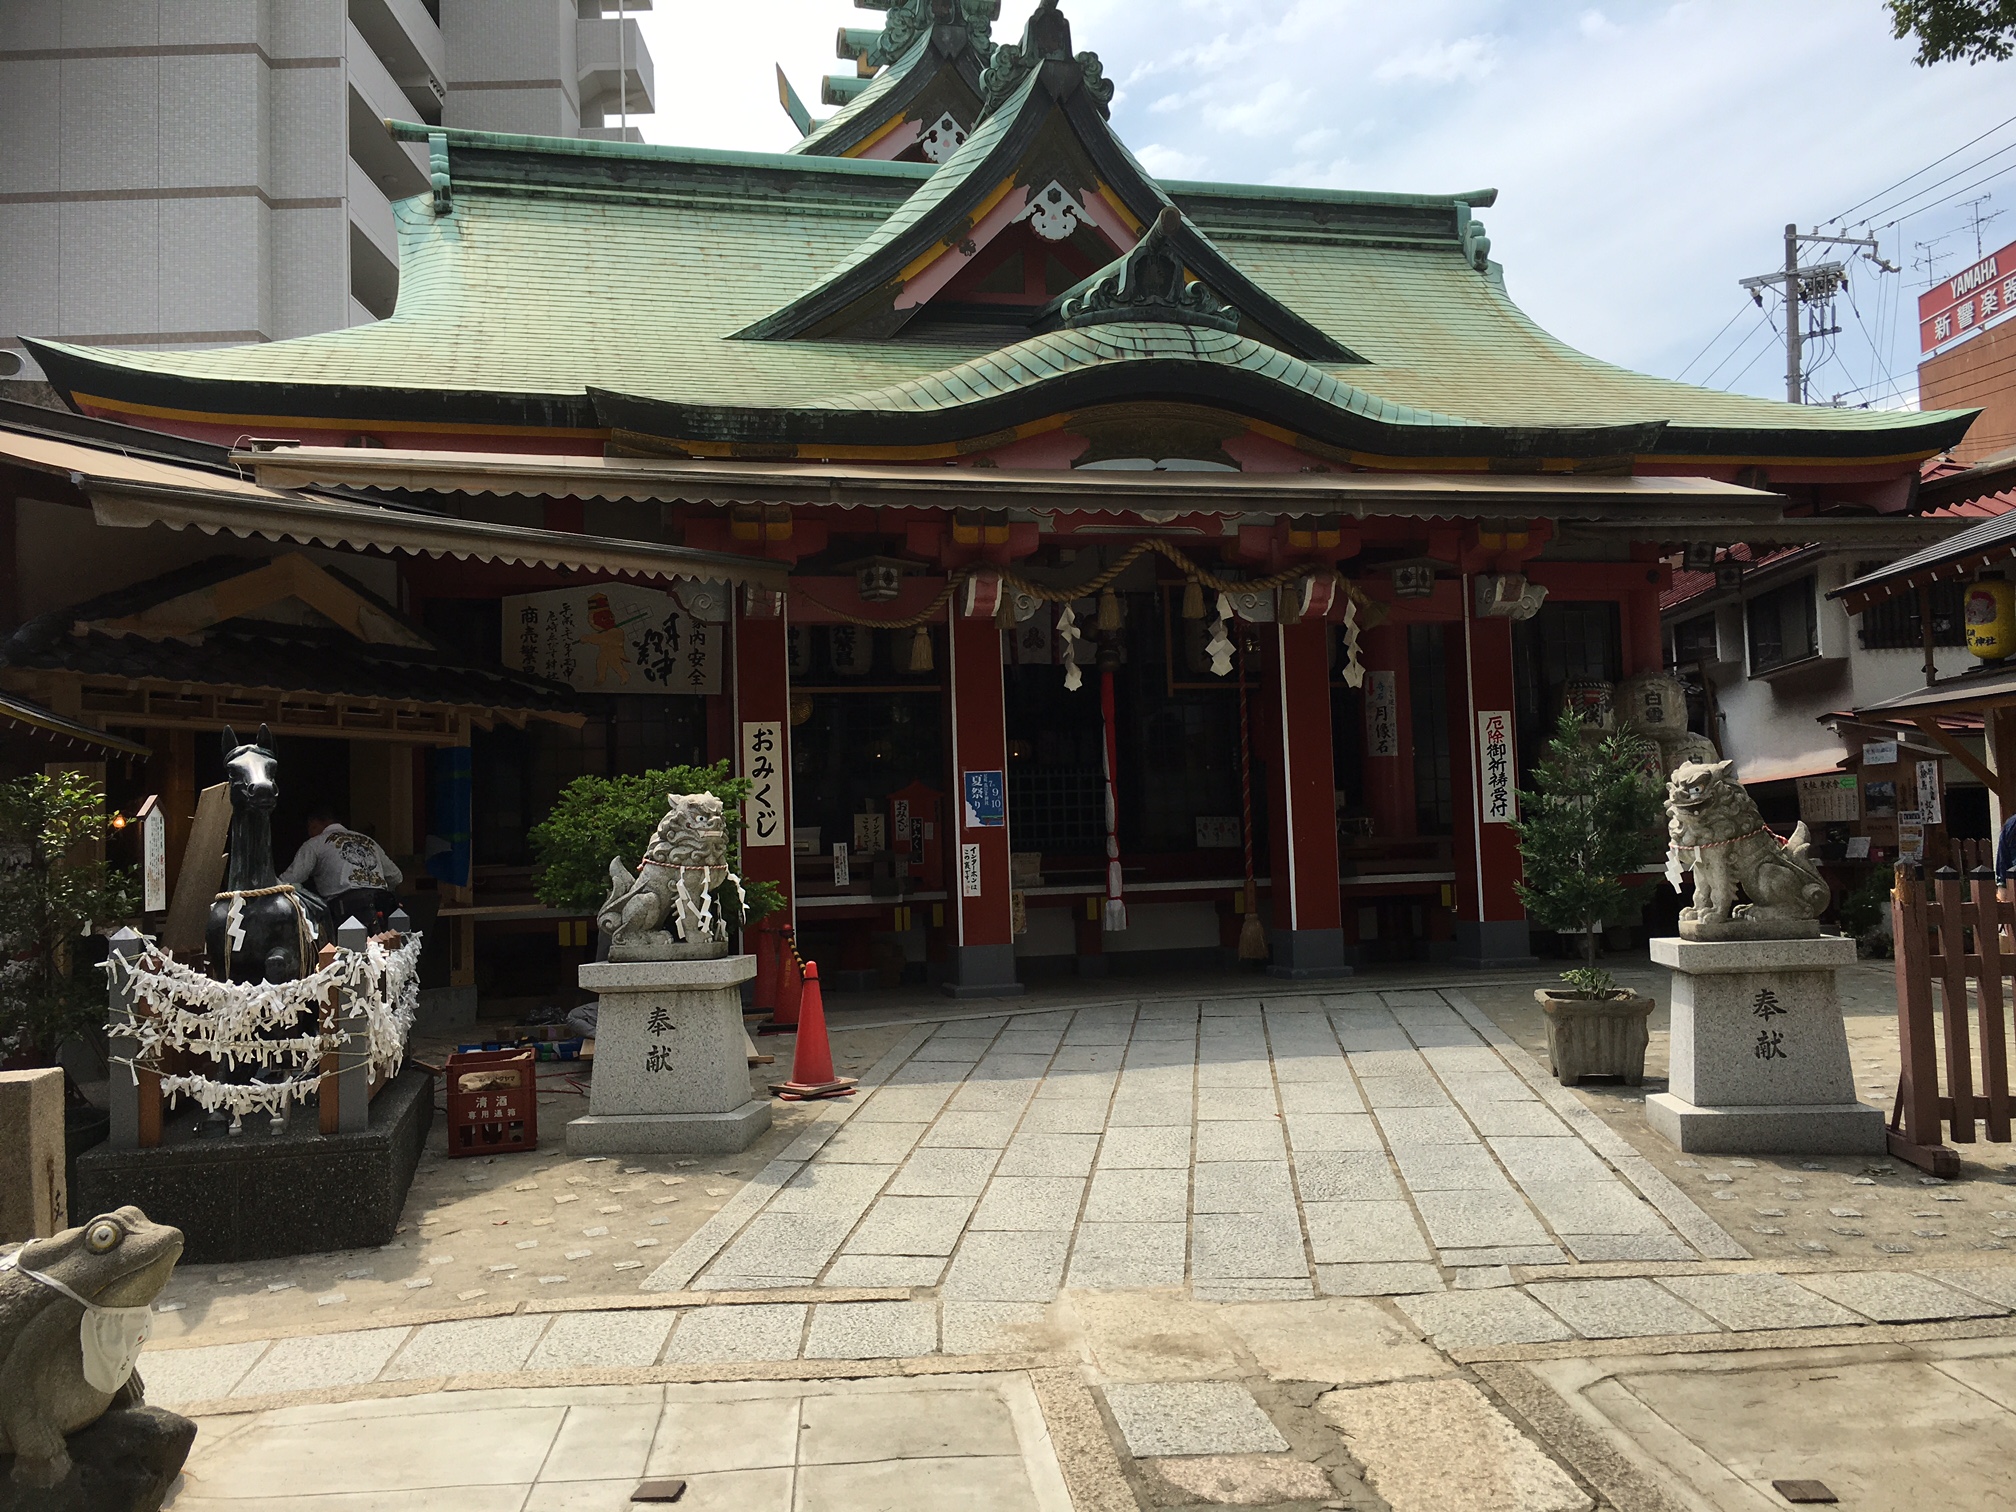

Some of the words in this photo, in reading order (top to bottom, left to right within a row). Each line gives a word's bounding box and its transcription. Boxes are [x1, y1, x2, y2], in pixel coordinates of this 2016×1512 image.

[1950, 257, 1997, 299] YAMAHA
[1934, 276, 2016, 340] 新響楽器
[1375, 706, 1391, 754] 月像石
[752, 728, 777, 838] おみくじ
[1486, 716, 1508, 817] 厄除御祈祷受付
[971, 774, 983, 809] 夏祭り
[991, 799, 1001, 808] 10
[992, 788, 999, 796] 9
[896, 801, 908, 832] おみくじ
[970, 846, 978, 890] インターホンは
[646, 1006, 676, 1073] 奉献
[1752, 988, 1787, 1061] 奉献
[475, 1095, 508, 1109] 清酒
